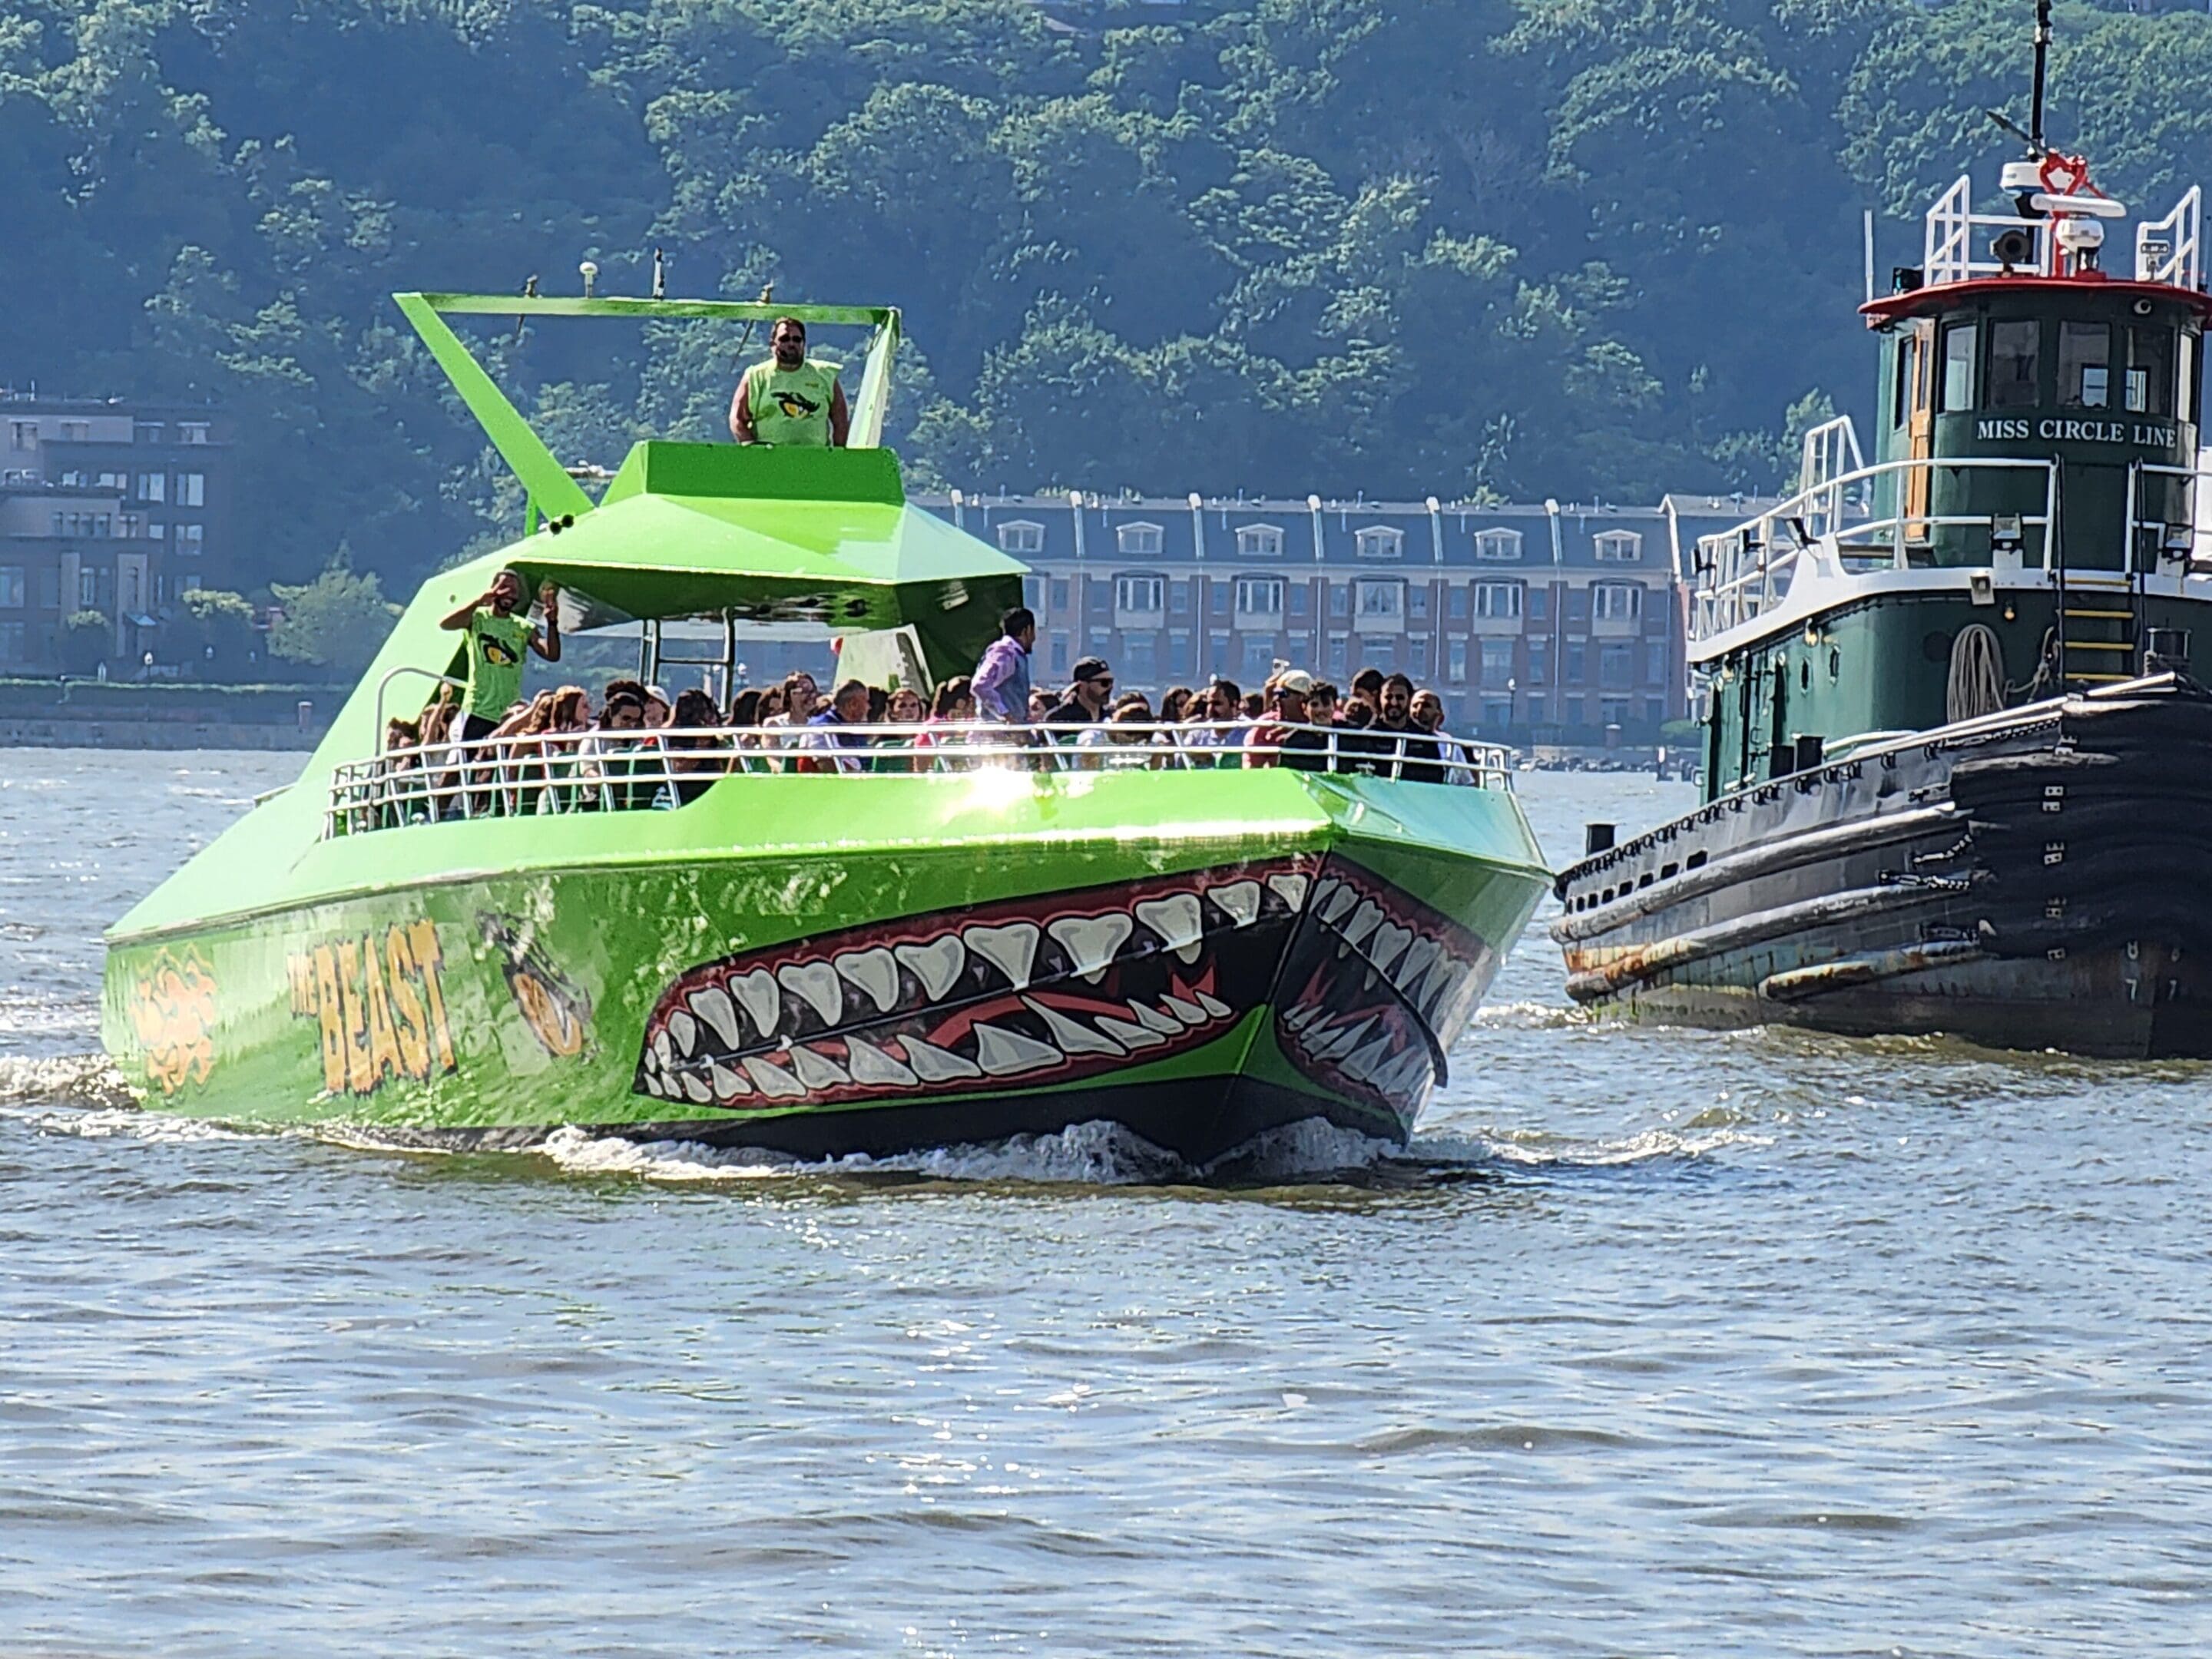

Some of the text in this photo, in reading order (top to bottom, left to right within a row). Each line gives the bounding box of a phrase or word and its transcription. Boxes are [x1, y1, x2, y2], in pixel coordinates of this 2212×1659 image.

[1977, 419, 2176, 449] MISS CIRCLE LINE
[2125, 979, 2137, 1001] 7
[314, 917, 458, 1095] BEAST
